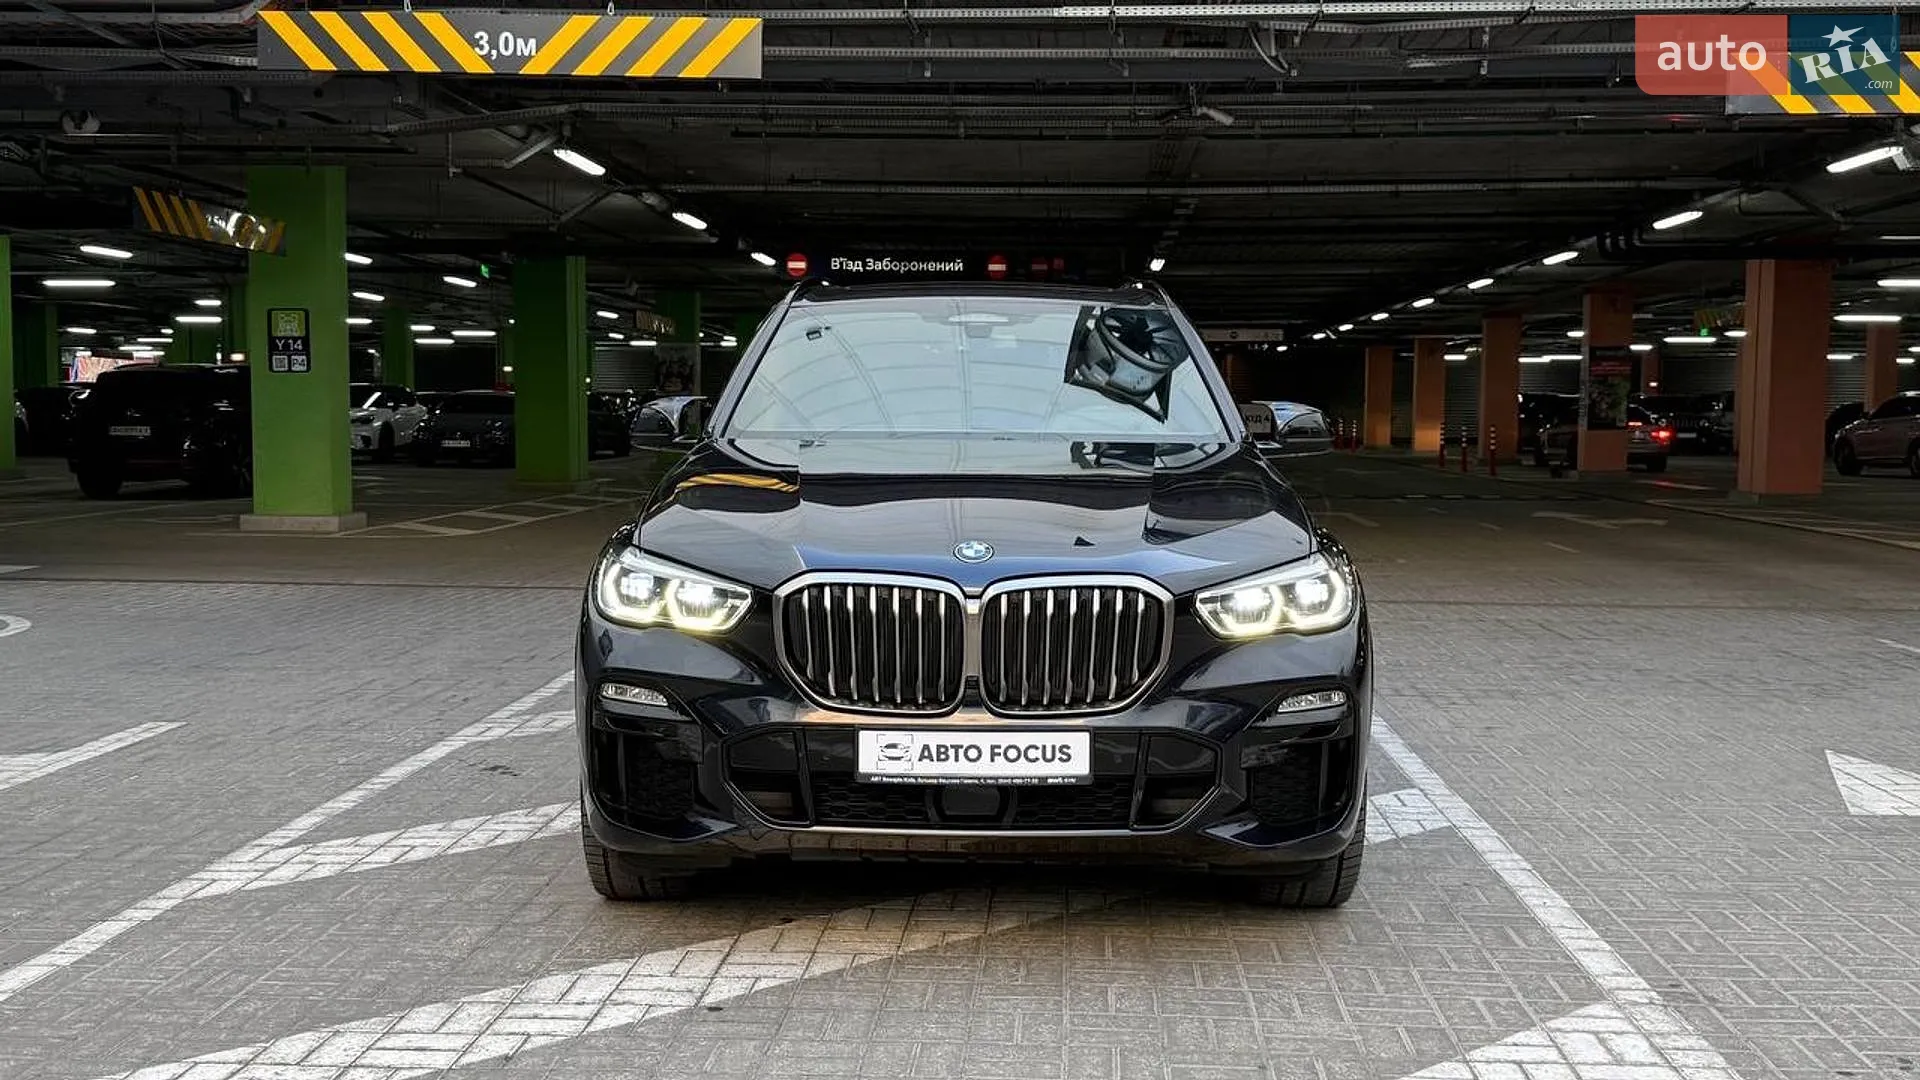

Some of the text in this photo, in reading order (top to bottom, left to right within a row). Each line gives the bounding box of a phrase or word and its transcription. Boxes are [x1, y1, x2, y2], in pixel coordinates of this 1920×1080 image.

[865, 257, 964, 274] Заборонений
[275, 339, 303, 350] Y 14
[917, 744, 1072, 763] АВТО FOCUS
